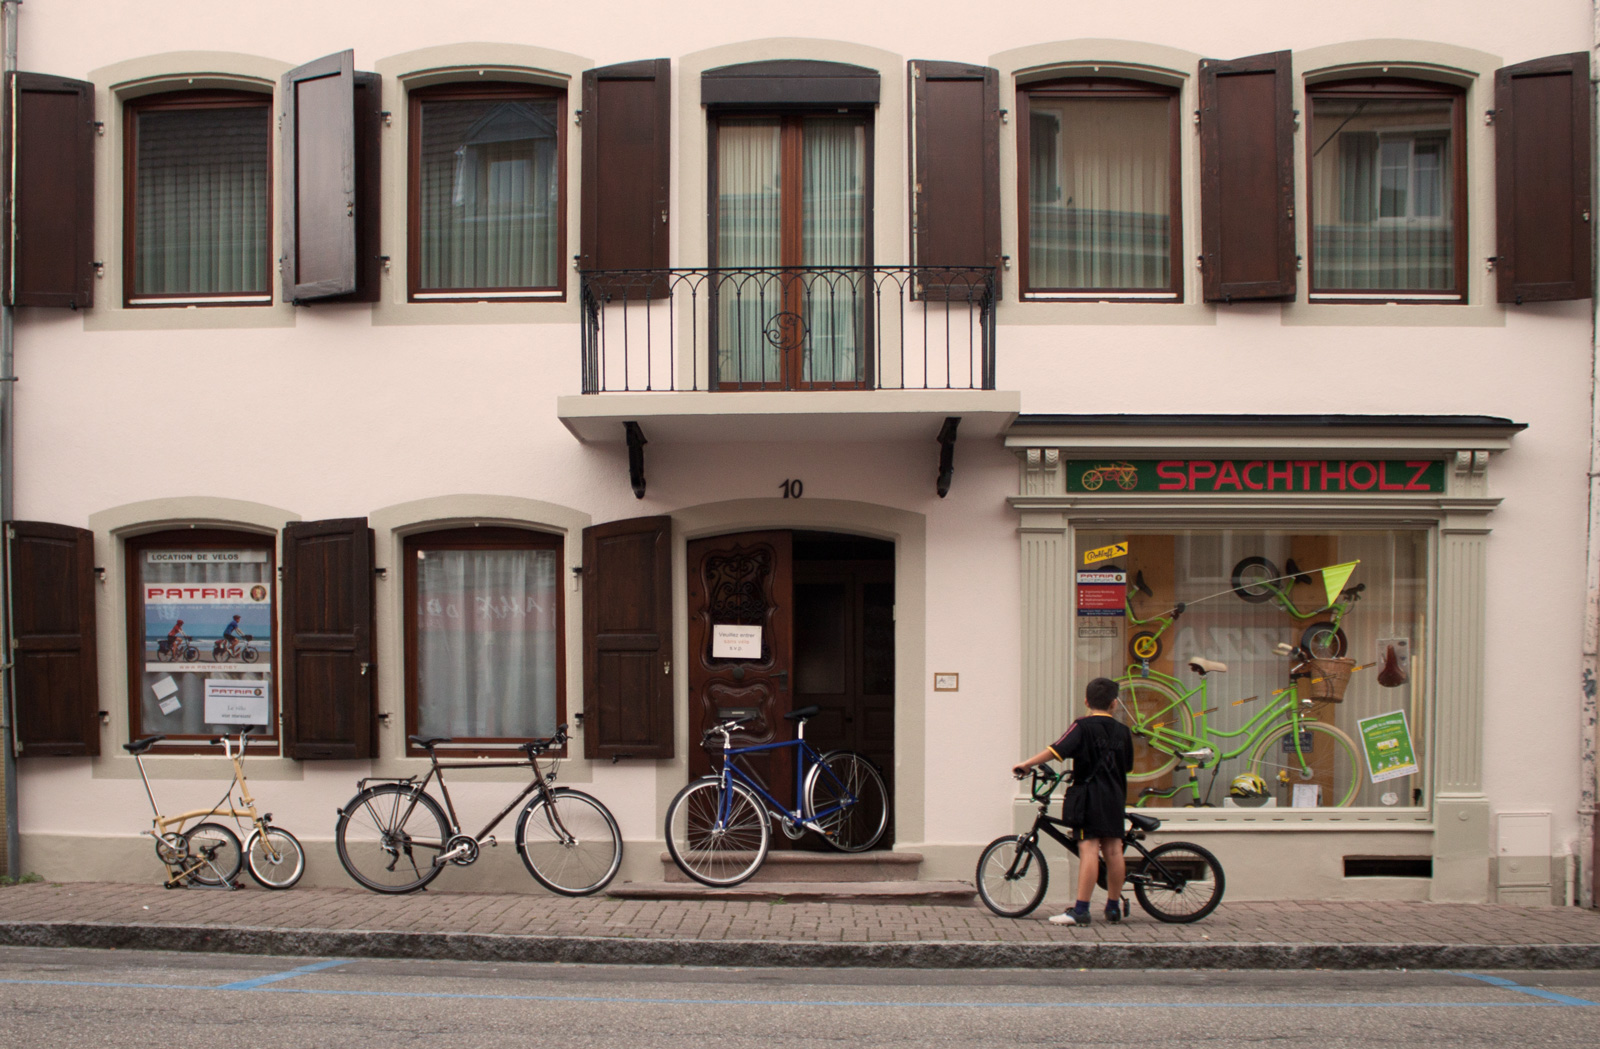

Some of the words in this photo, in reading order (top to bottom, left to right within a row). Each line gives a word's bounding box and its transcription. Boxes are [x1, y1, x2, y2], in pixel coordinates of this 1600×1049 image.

[1156, 460, 1433, 491] SPACHTHOLZ
[778, 478, 804, 499] 10
[151, 553, 193, 561] LOCATION
[196, 553, 208, 561] DE
[212, 553, 239, 561] VELOS
[147, 588, 244, 599] PATRIA
